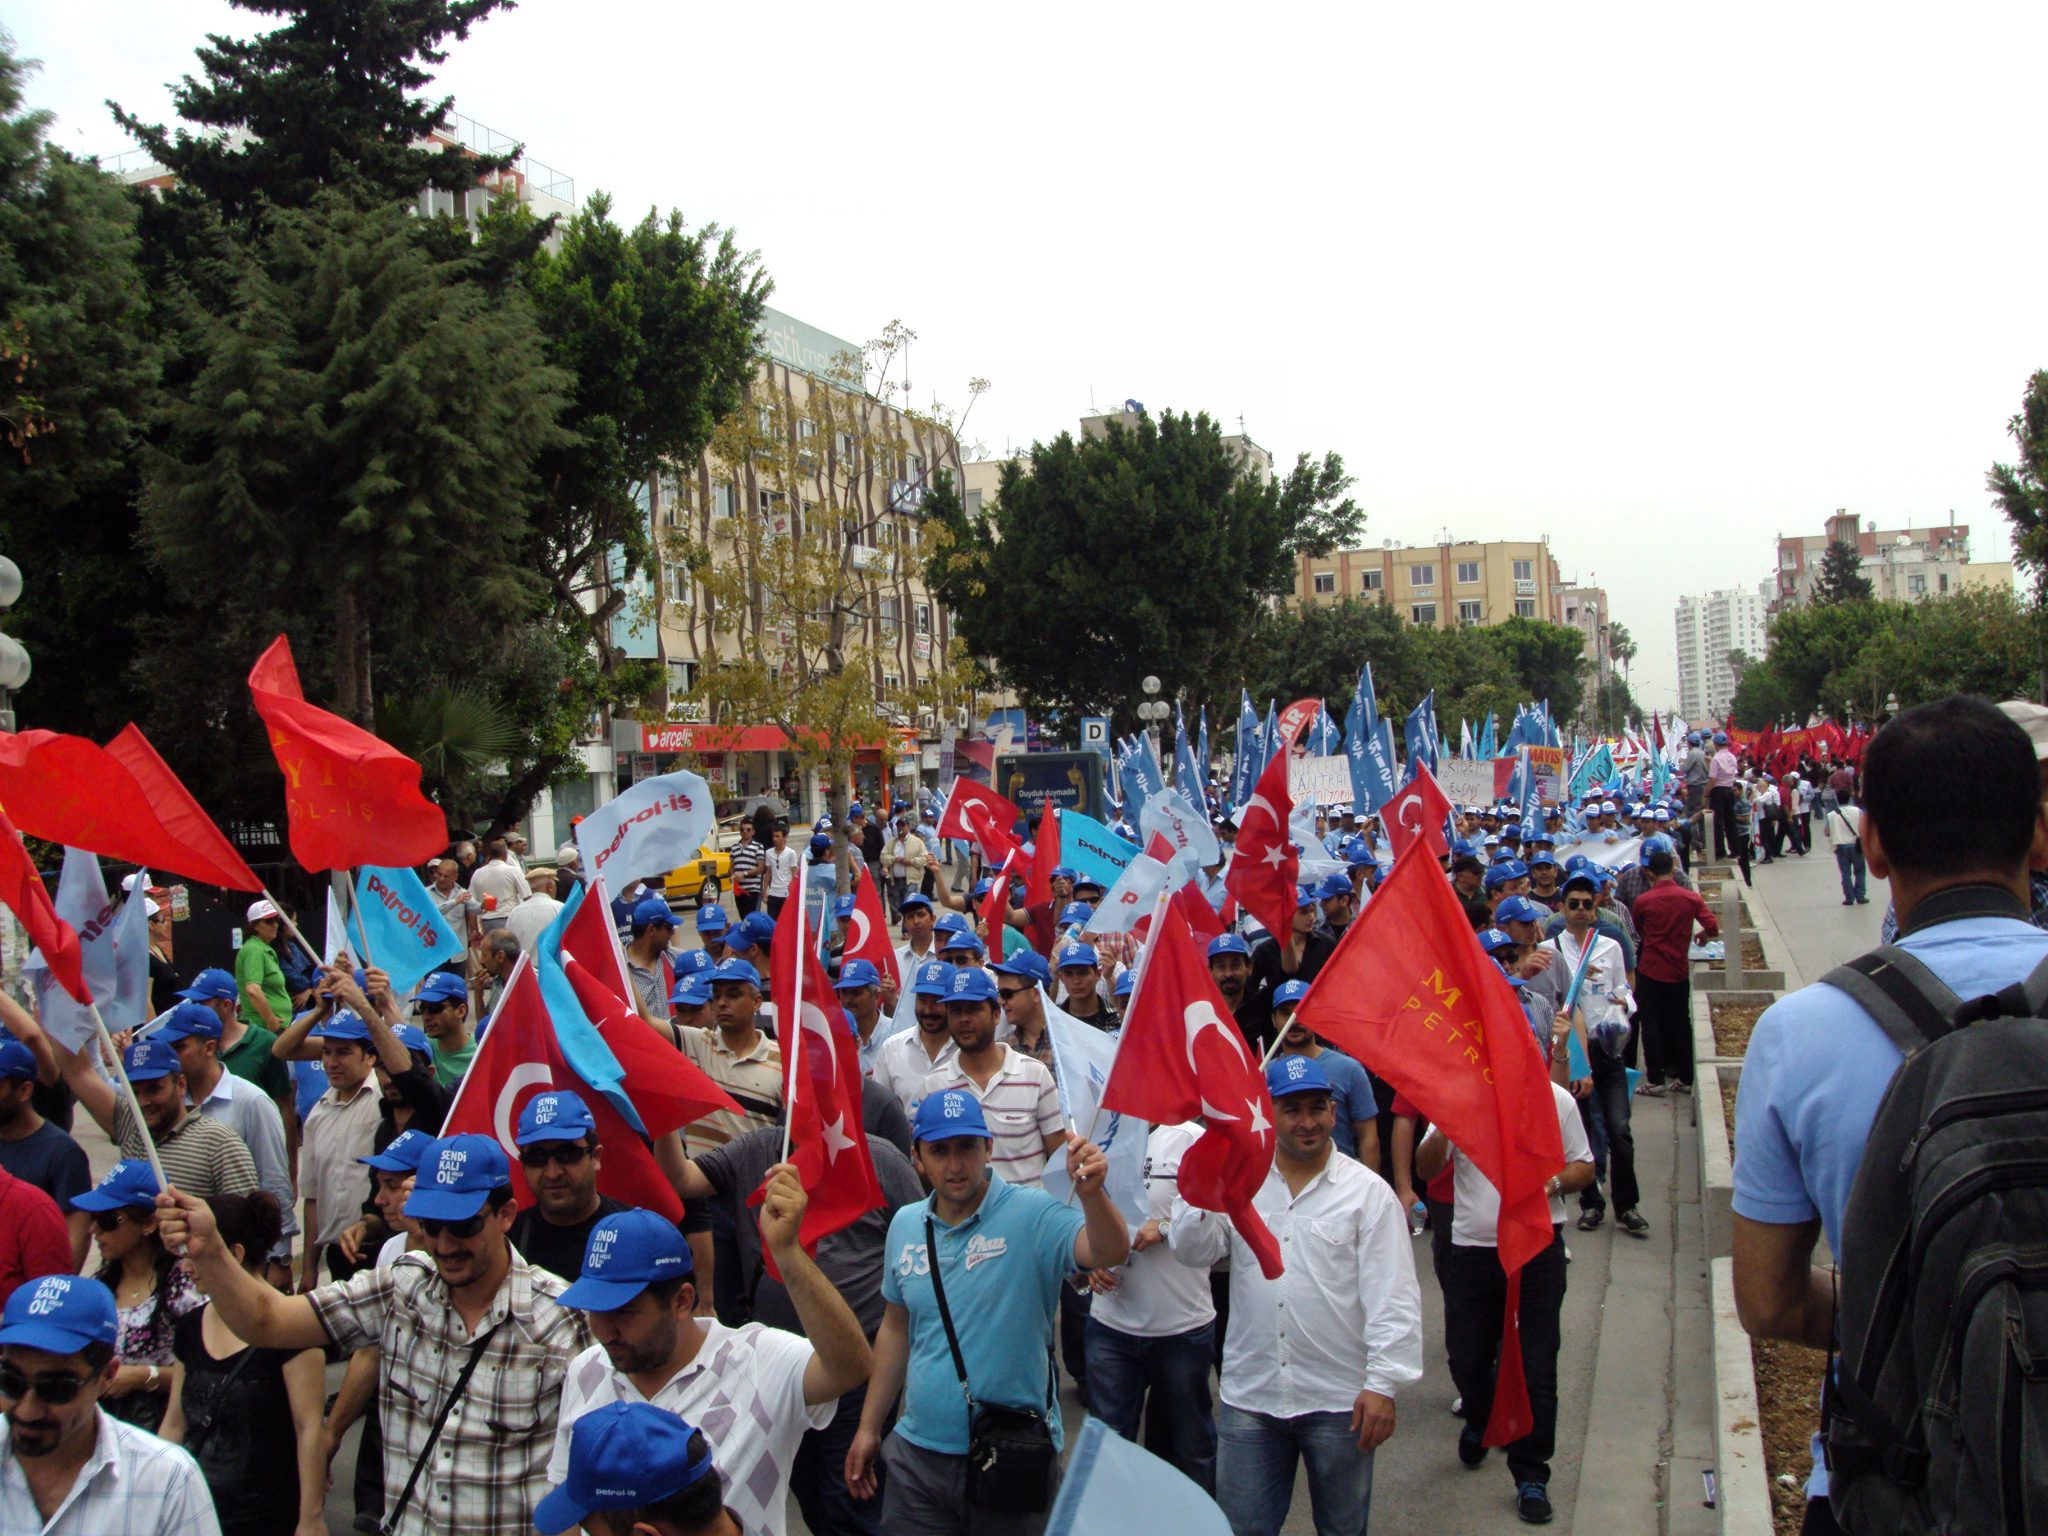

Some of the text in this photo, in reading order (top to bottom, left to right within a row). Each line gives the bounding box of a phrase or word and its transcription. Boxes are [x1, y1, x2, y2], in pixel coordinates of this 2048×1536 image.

[1089, 725, 1101, 739] D
[594, 794, 693, 870] petrol-iş
[367, 874, 439, 948] petrol-iş
[898, 1243, 931, 1276] 53
